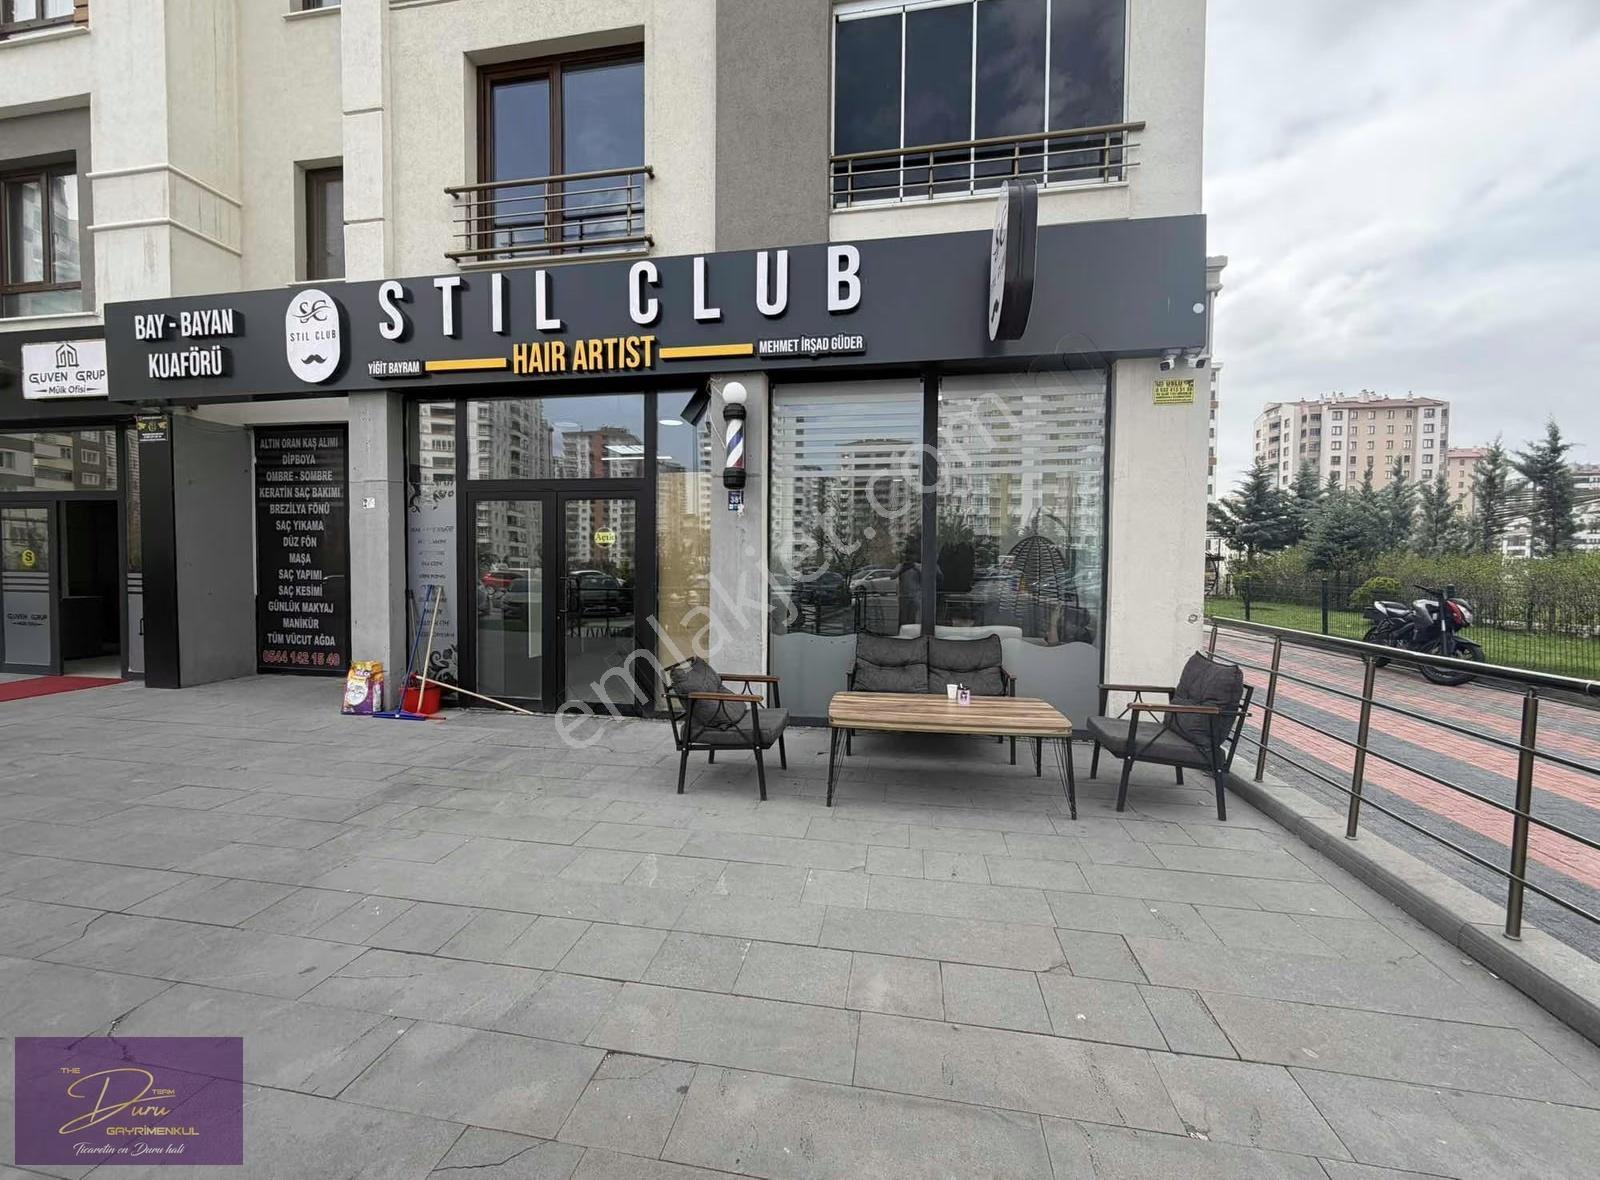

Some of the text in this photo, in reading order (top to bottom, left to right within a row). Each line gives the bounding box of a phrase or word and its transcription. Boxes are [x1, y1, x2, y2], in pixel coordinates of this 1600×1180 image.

[378, 244, 861, 340] STIL CLUB
[134, 313, 165, 340] BAY
[180, 308, 234, 337] BAYAN
[290, 329, 336, 342] STIL CLUB
[759, 333, 863, 354] MEHMET İRŞAD GÜDER
[148, 345, 223, 378] KUAFÖRÜ
[513, 335, 655, 374] HAIR ARTIST
[368, 360, 420, 375] YİĞİT BAYRAM
[29, 369, 106, 384] GUVEN GRUP
[48, 384, 86, 394] Mülk Ofisi
[260, 437, 338, 451] ALTIN ORAN KAŞ ALIMI
[282, 453, 316, 466] DİPBOYA
[266, 470, 294, 481] OMBRE
[300, 470, 333, 481] SOMBRE
[259, 486, 341, 501] KERATİN SAÇ BAKIMI
[270, 502, 330, 515] BREZİLYA FÖNÜ
[276, 520, 324, 534] SAÇ YIKAMA
[283, 534, 317, 548] DÜZ FÖN
[289, 552, 311, 565] MAŞA
[278, 569, 322, 583] SAÇ YAPIMI
[278, 584, 323, 599] SAÇ KESİMİ
[268, 600, 334, 613] GÜNLÜK MAKYAJ
[267, 632, 336, 646] TÜM VÜCUT AĞDA
